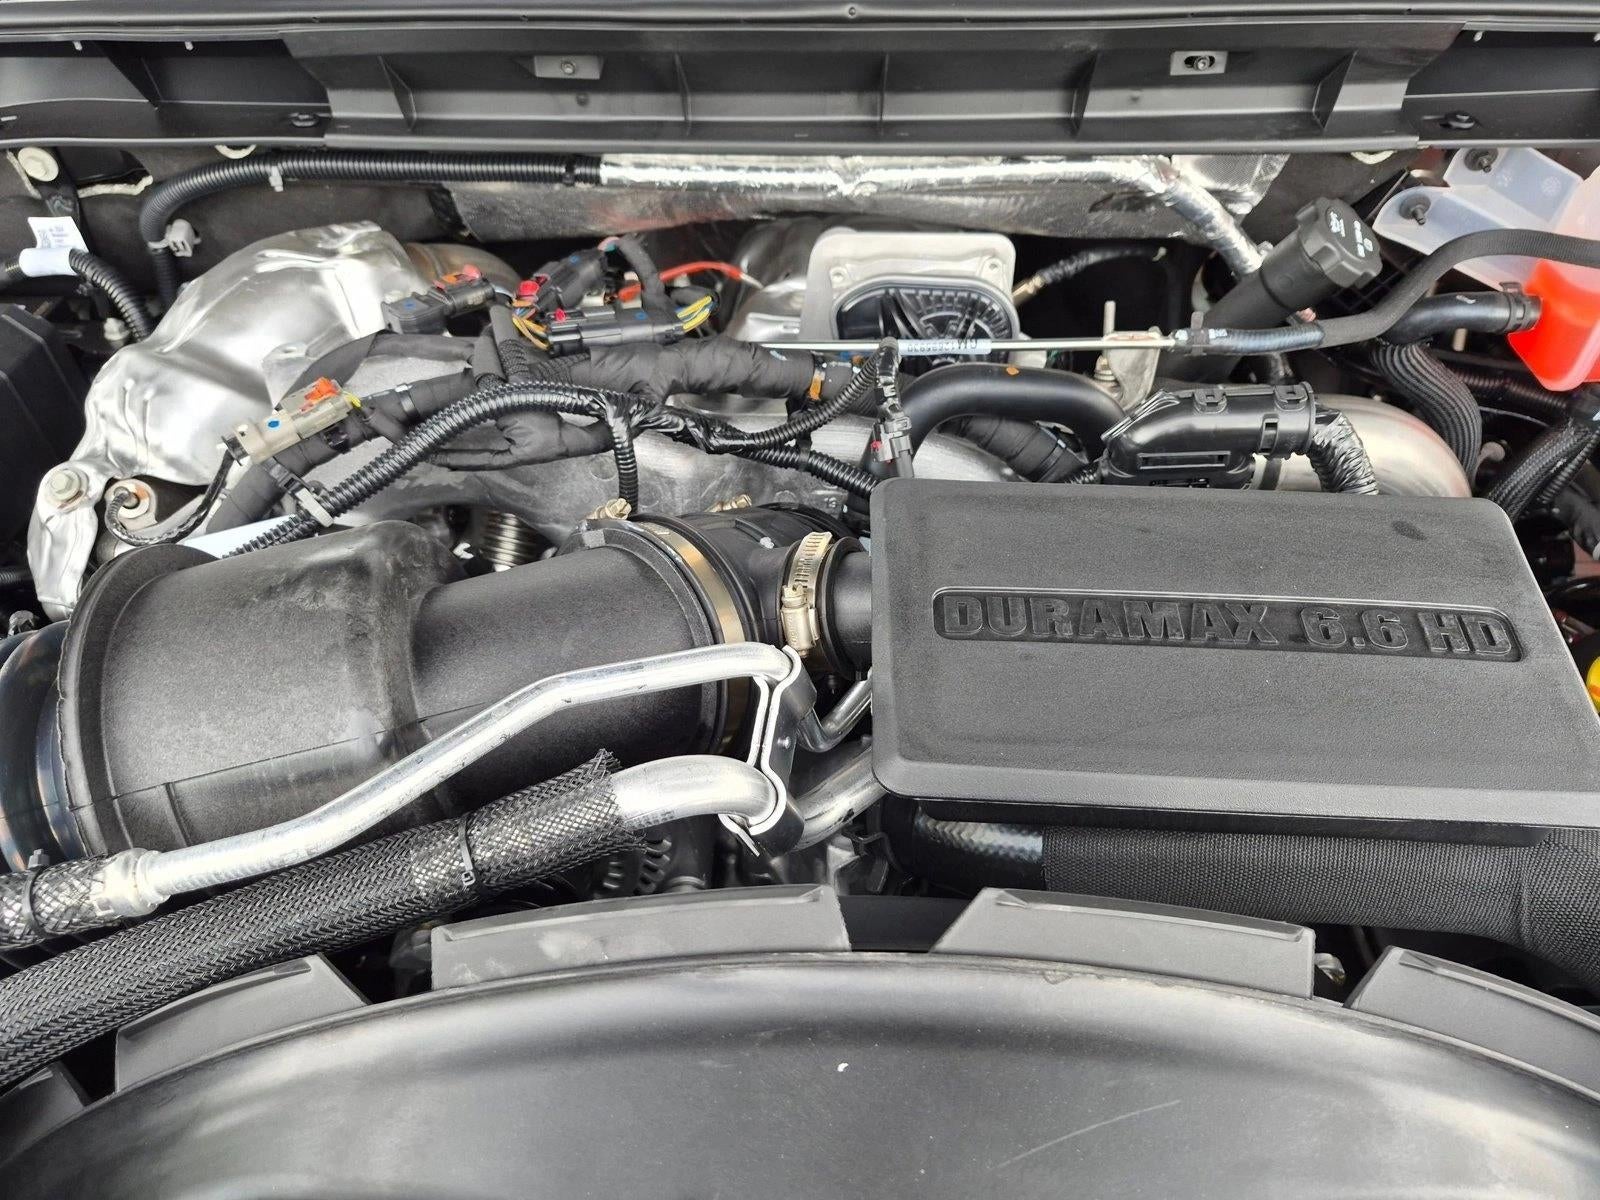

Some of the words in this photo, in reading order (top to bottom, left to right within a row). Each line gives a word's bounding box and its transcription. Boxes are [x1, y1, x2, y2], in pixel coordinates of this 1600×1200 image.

[943, 597, 1279, 645] DURAMAX
[1300, 605, 1409, 650] 6.6
[1417, 611, 1512, 656] HD
